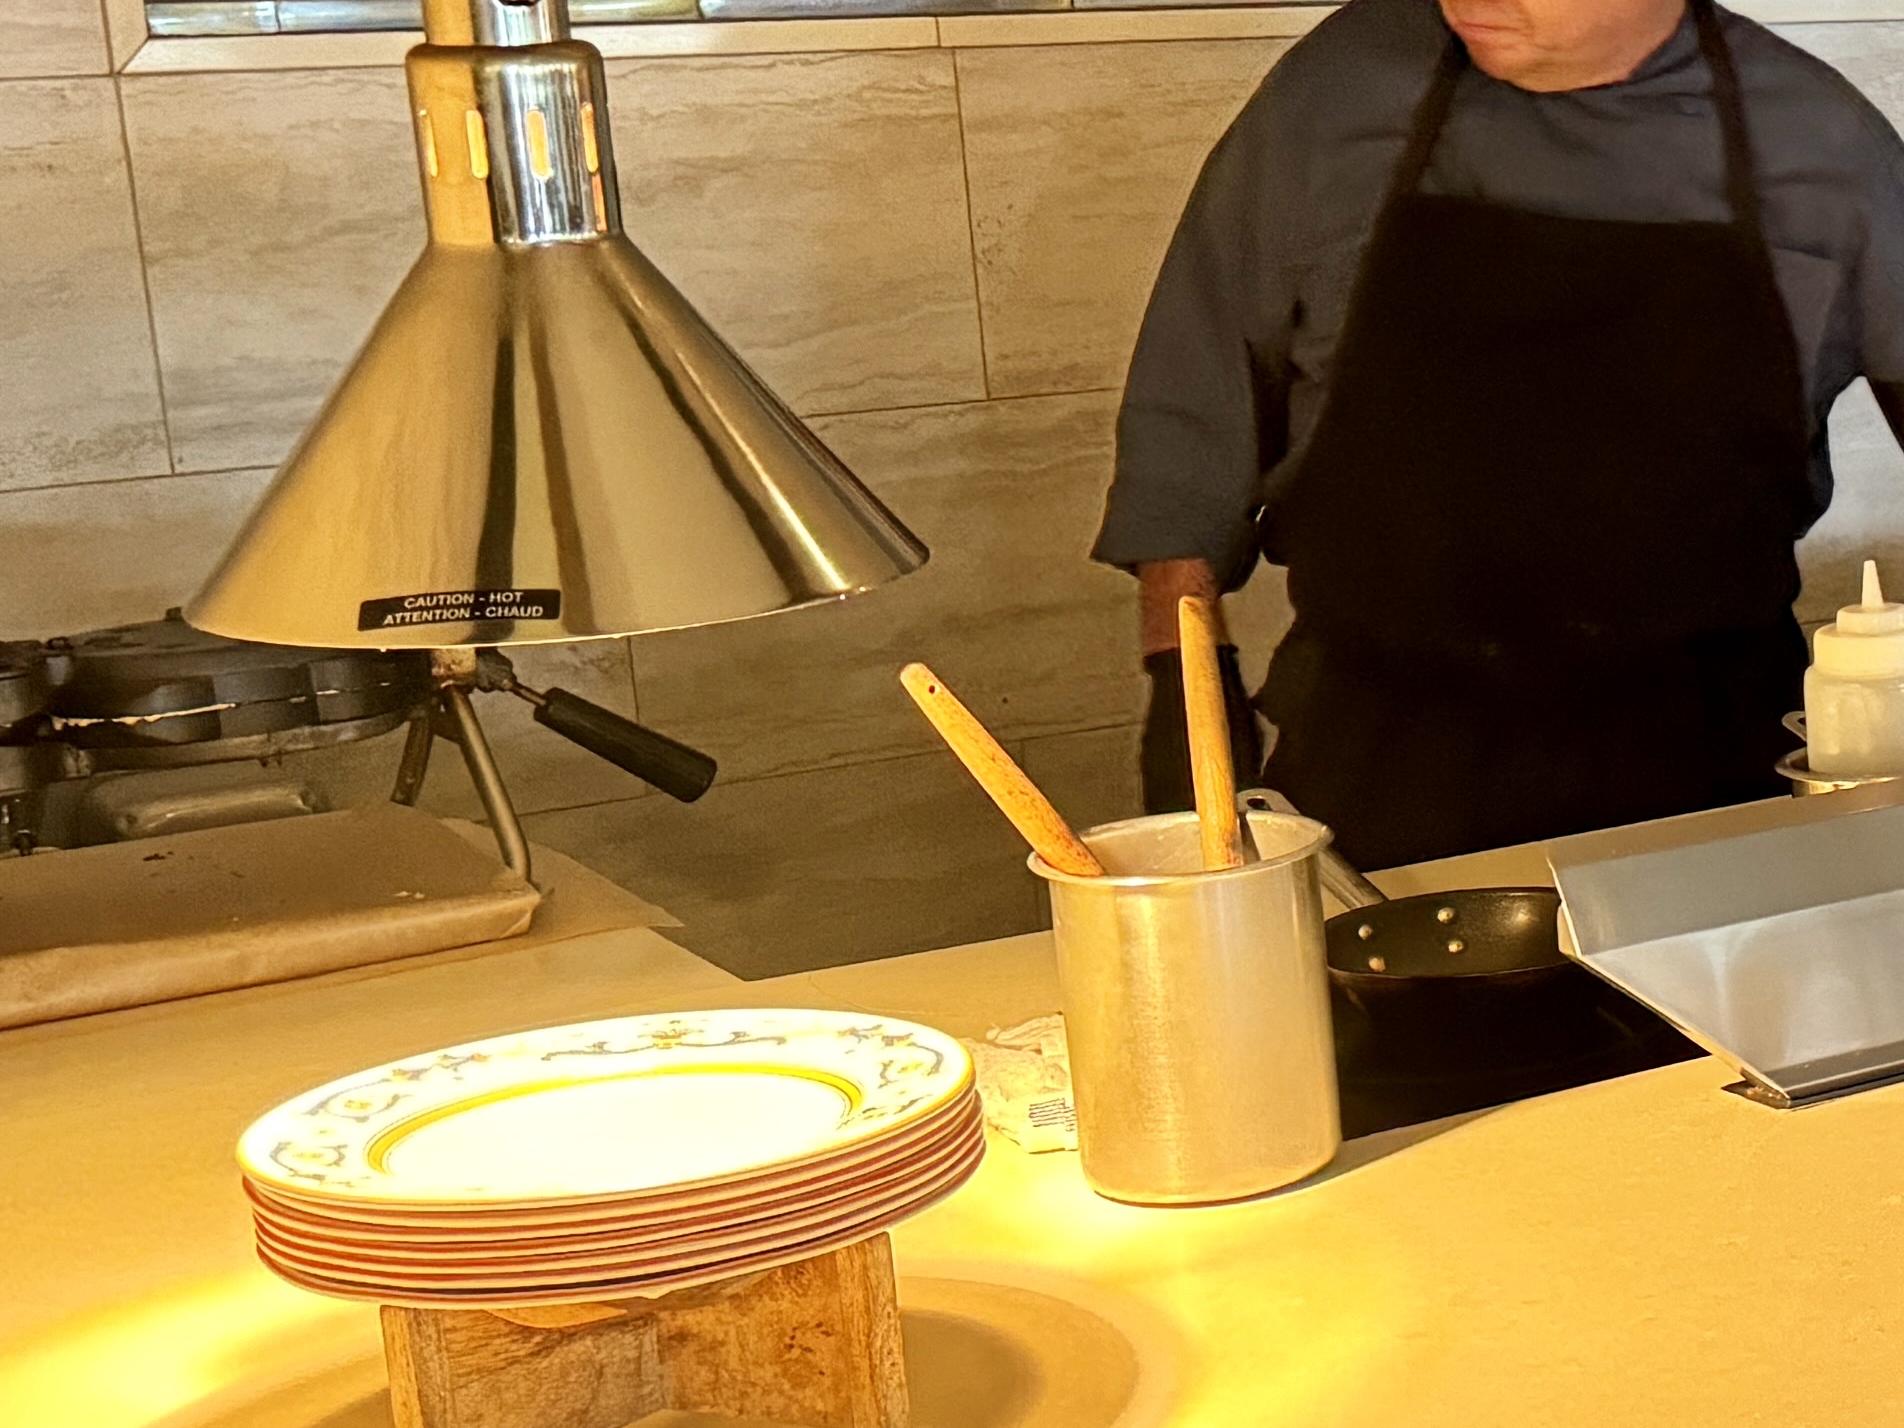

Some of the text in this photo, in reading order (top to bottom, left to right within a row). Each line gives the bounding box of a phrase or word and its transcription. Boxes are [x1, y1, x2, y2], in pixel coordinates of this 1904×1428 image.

[403, 593, 475, 608] CAUTION
[488, 591, 524, 603] HOT
[382, 607, 470, 625] ATTENTION
[485, 605, 543, 618] CHAUD
